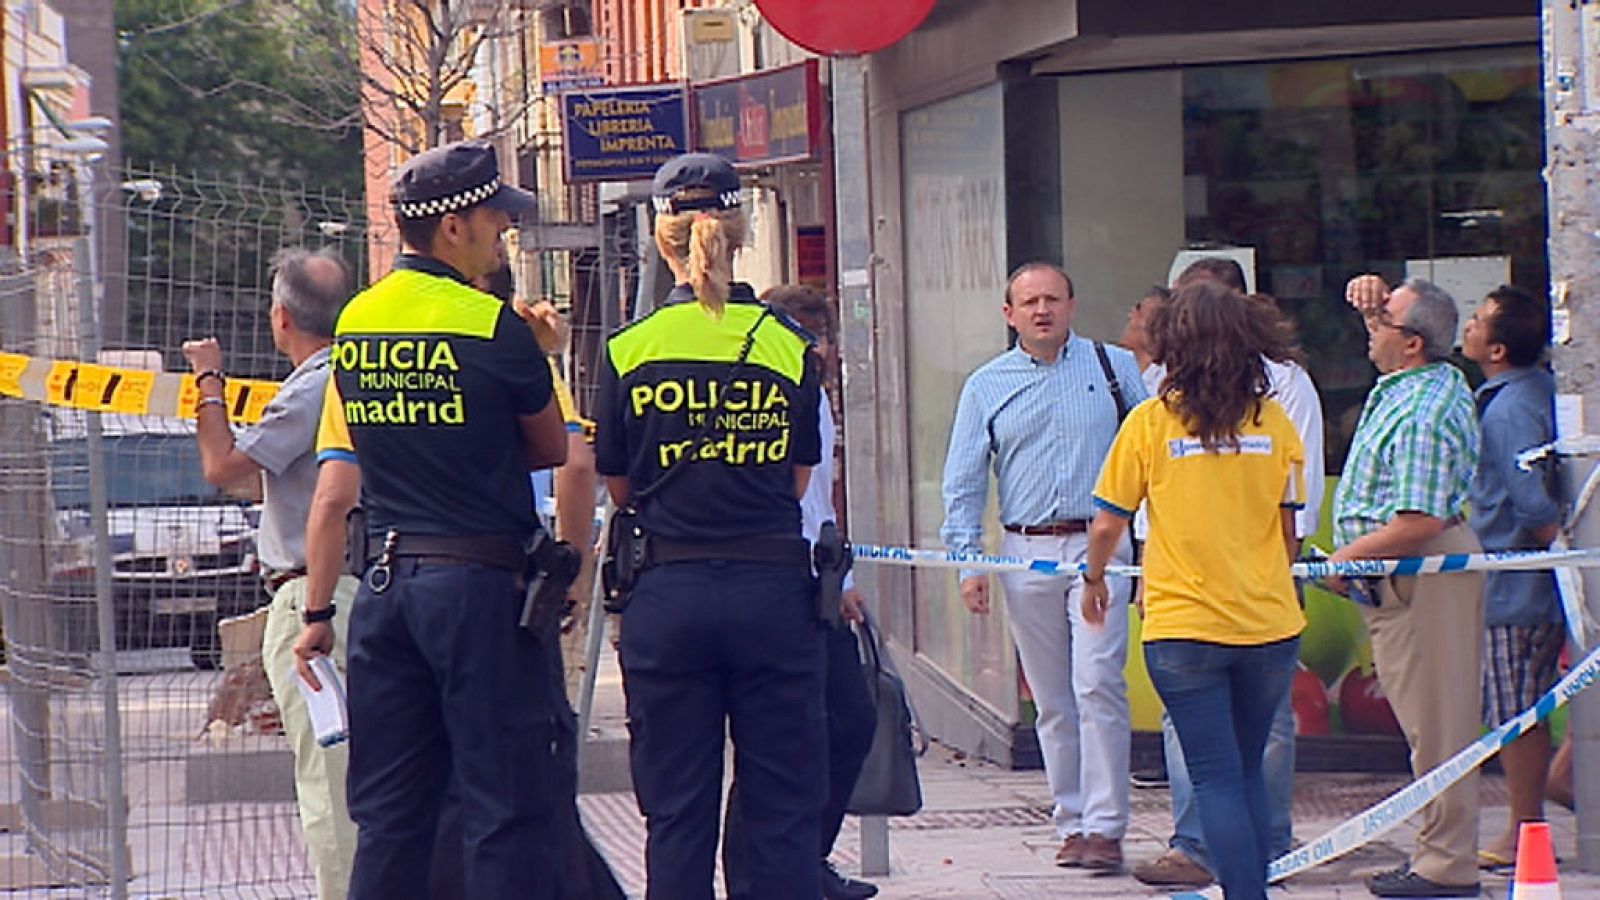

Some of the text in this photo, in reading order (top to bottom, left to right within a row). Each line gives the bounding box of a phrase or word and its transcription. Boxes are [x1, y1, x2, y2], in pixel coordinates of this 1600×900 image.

[601, 134, 676, 153] IMPRENTA
[360, 371, 462, 392] MUNICIPAL
[345, 391, 465, 424] madrid
[688, 410, 790, 430] MNICIPAL
